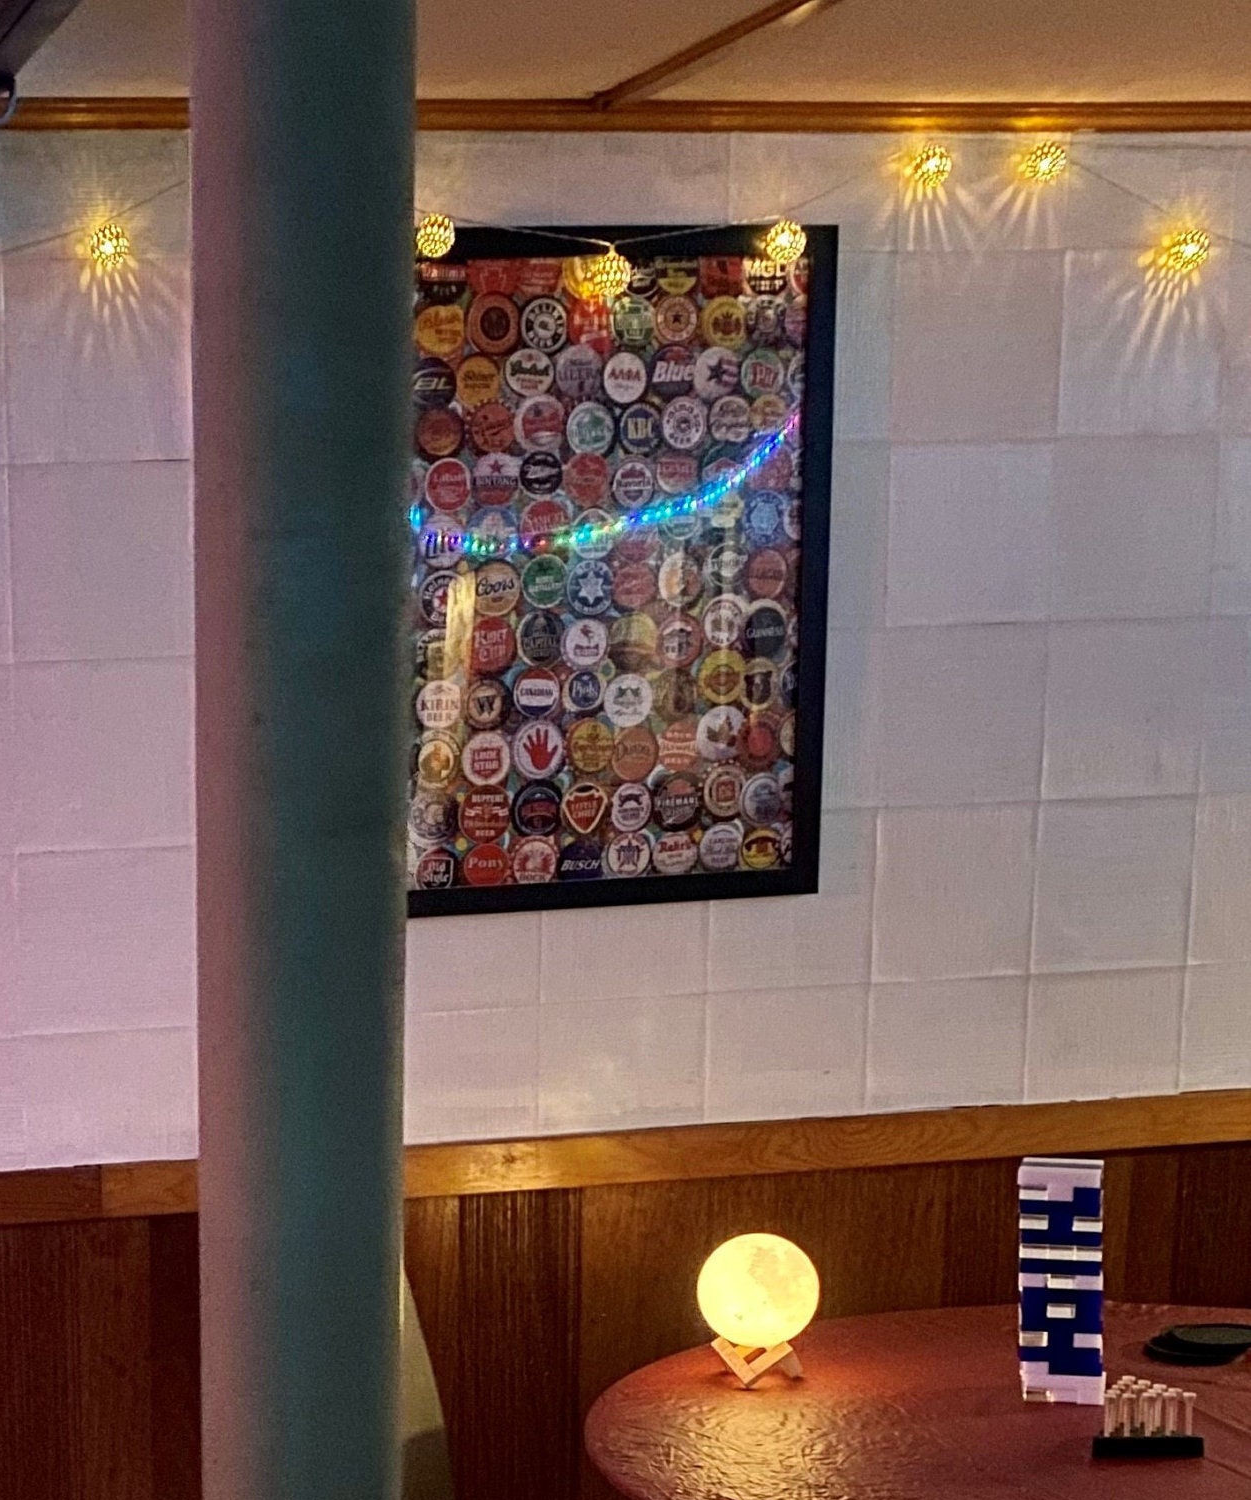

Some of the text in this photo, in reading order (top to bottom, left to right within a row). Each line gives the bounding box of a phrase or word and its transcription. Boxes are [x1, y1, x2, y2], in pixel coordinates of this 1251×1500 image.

[652, 360, 695, 383] Blue
[476, 577, 515, 597] Coors
[420, 698, 460, 711] KIRIN
[467, 857, 503, 870] Pony
[560, 858, 602, 872] BUSCH
